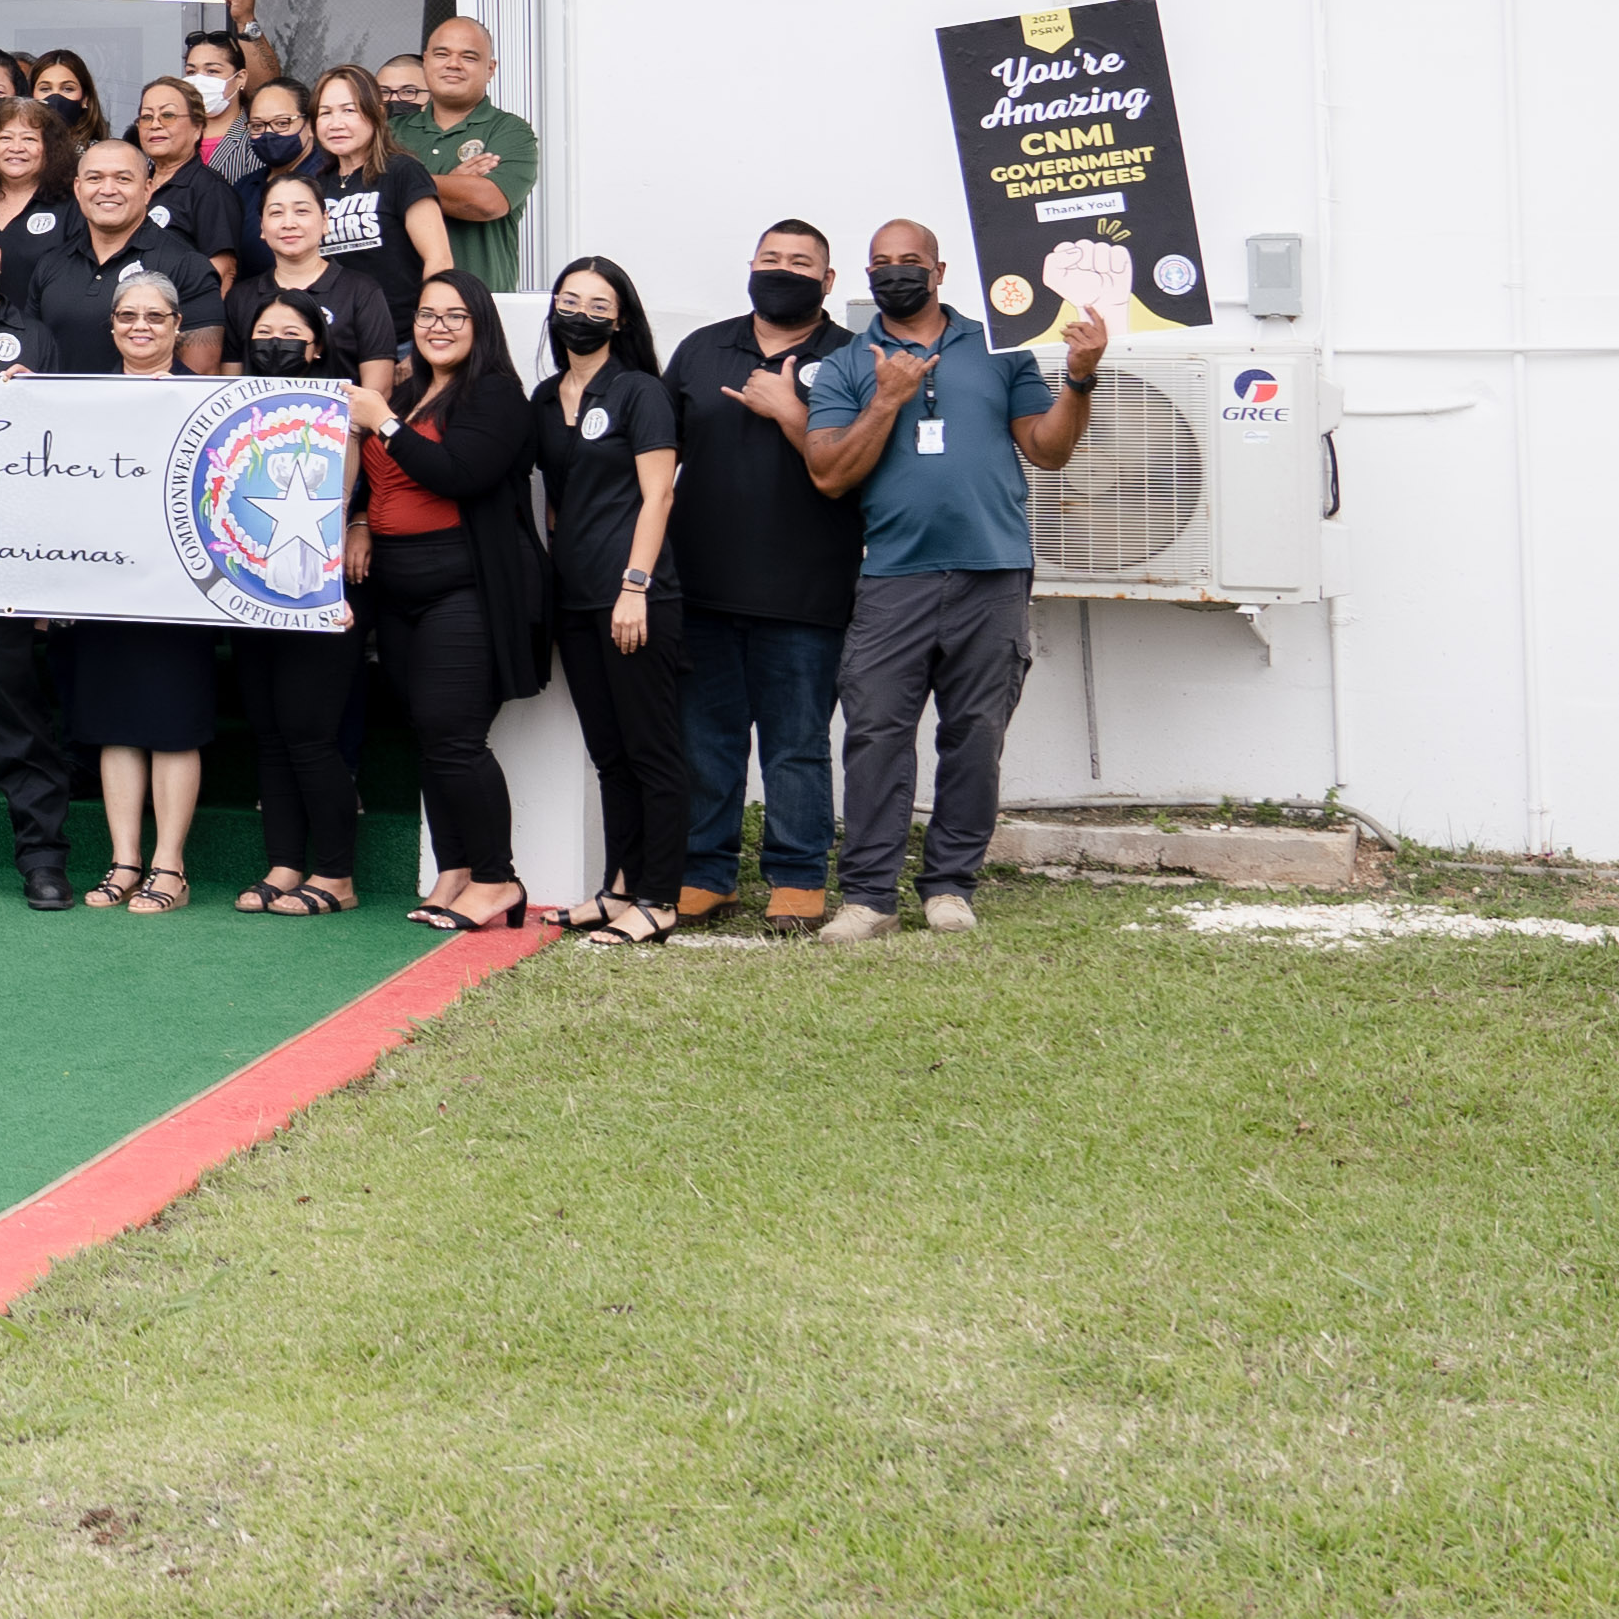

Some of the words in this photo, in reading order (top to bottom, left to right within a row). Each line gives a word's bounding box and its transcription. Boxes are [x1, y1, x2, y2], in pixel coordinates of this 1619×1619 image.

[1030, 24, 1066, 37] PSRW
[1032, 13, 1060, 25] 2022
[990, 47, 1126, 98] You're
[980, 86, 1152, 129] Amazing
[1020, 123, 1115, 156] CNMI
[990, 146, 1155, 183] GOVERNMENT
[1005, 166, 1146, 199] EMPLOYEES
[324, 191, 380, 219] OUTH
[1044, 202, 1085, 216] Thank
[1087, 198, 1117, 212] You!
[1222, 406, 1291, 422] GREE
[108, 452, 152, 479] to
[171, 413, 213, 571] COMMONWEALTH
[210, 392, 234, 417] OF
[234, 379, 276, 402] THE
[228, 594, 315, 629] OFFICIAL
